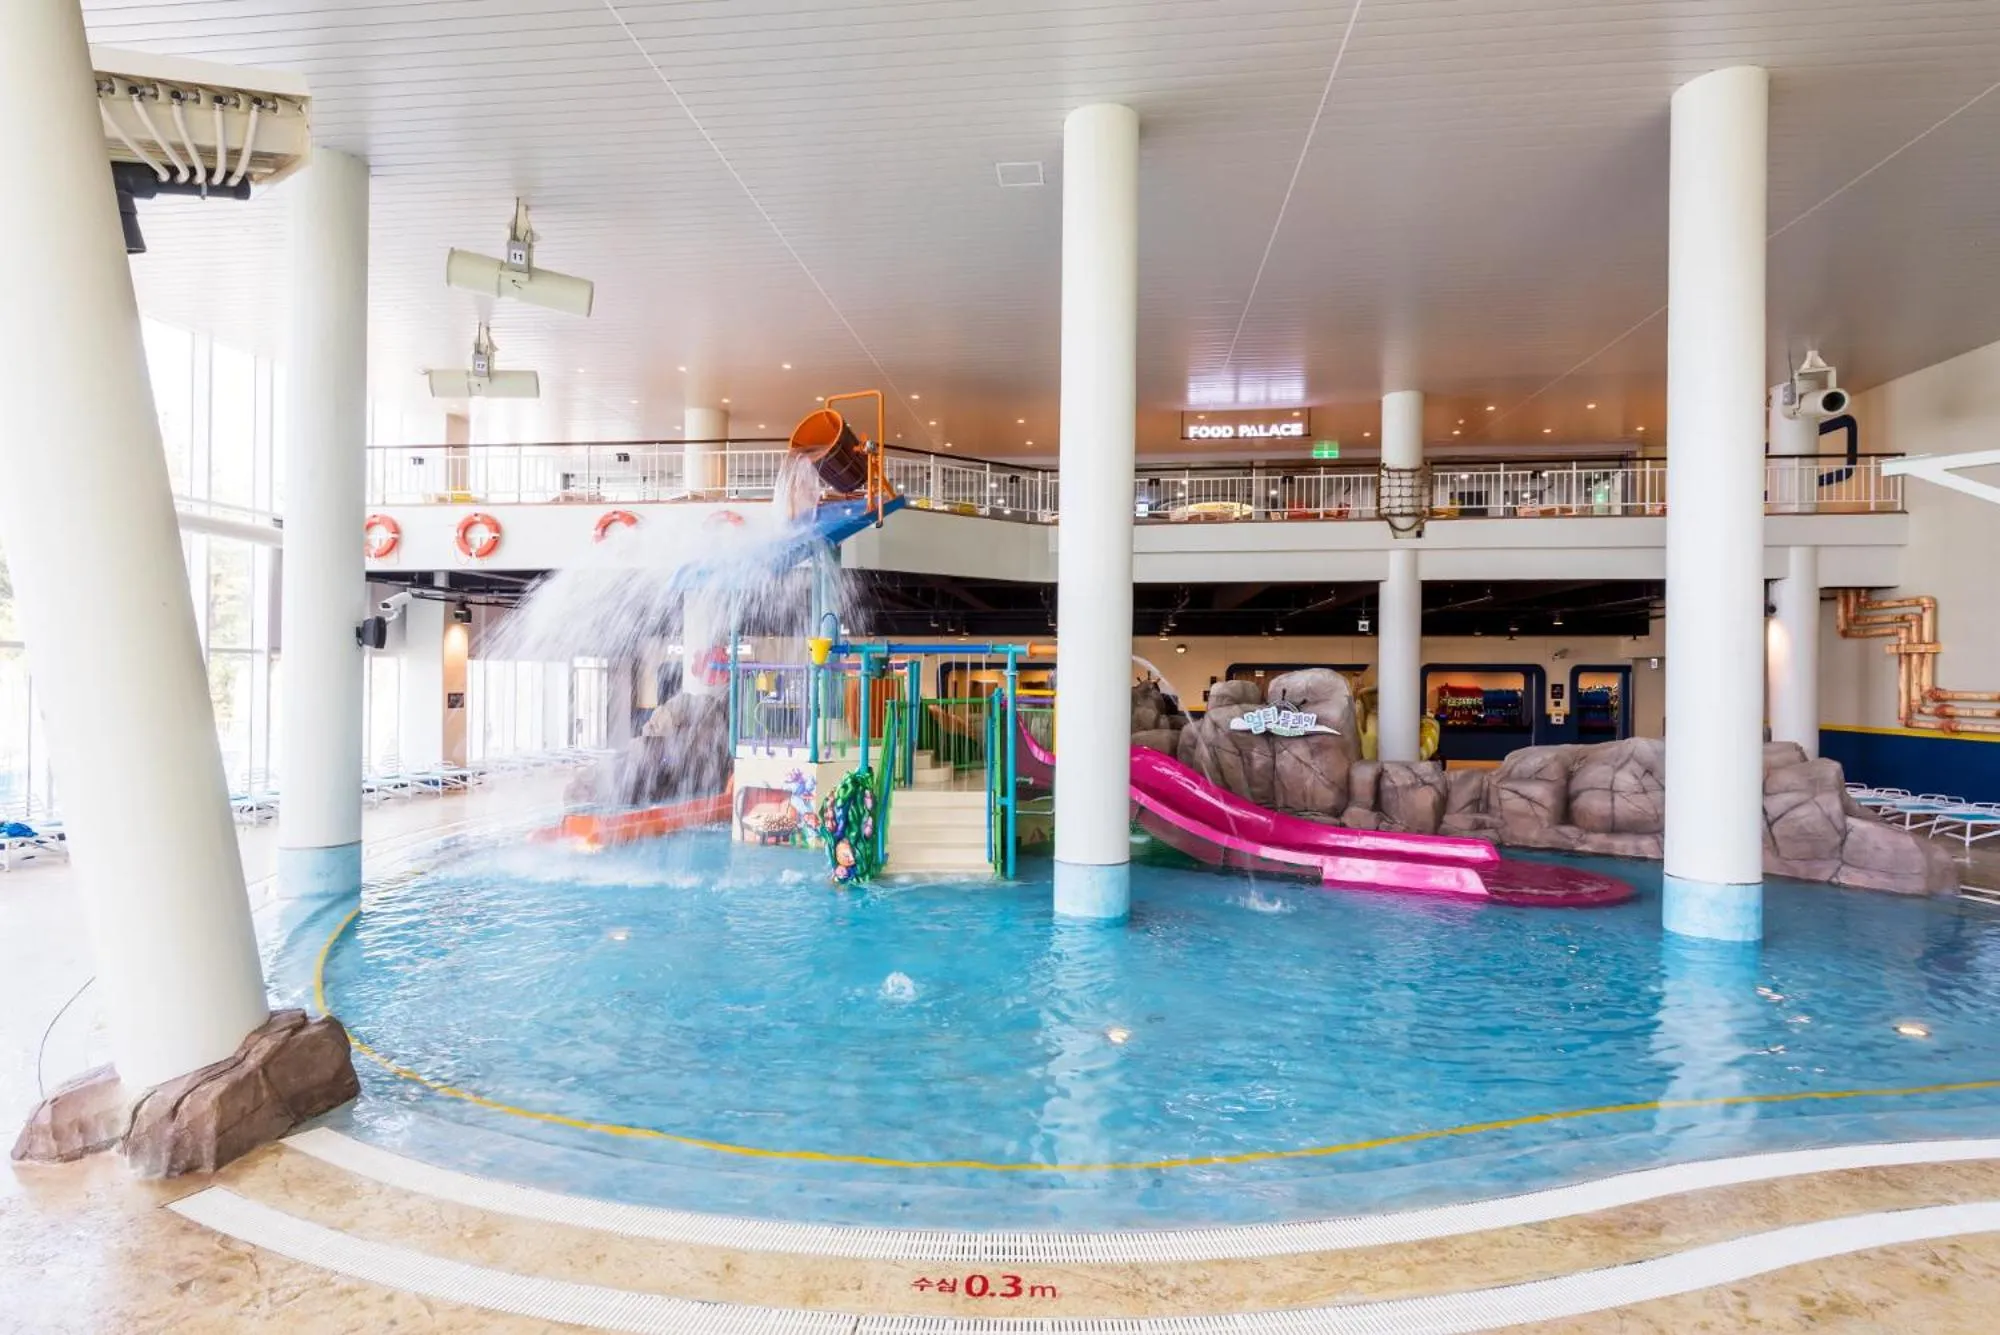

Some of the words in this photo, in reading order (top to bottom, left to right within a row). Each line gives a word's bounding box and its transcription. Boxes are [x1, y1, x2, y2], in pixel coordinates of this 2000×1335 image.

[1188, 425, 1234, 438] FOOD
[1238, 423, 1303, 437] PALACE
[911, 1277, 957, 1293] 수심
